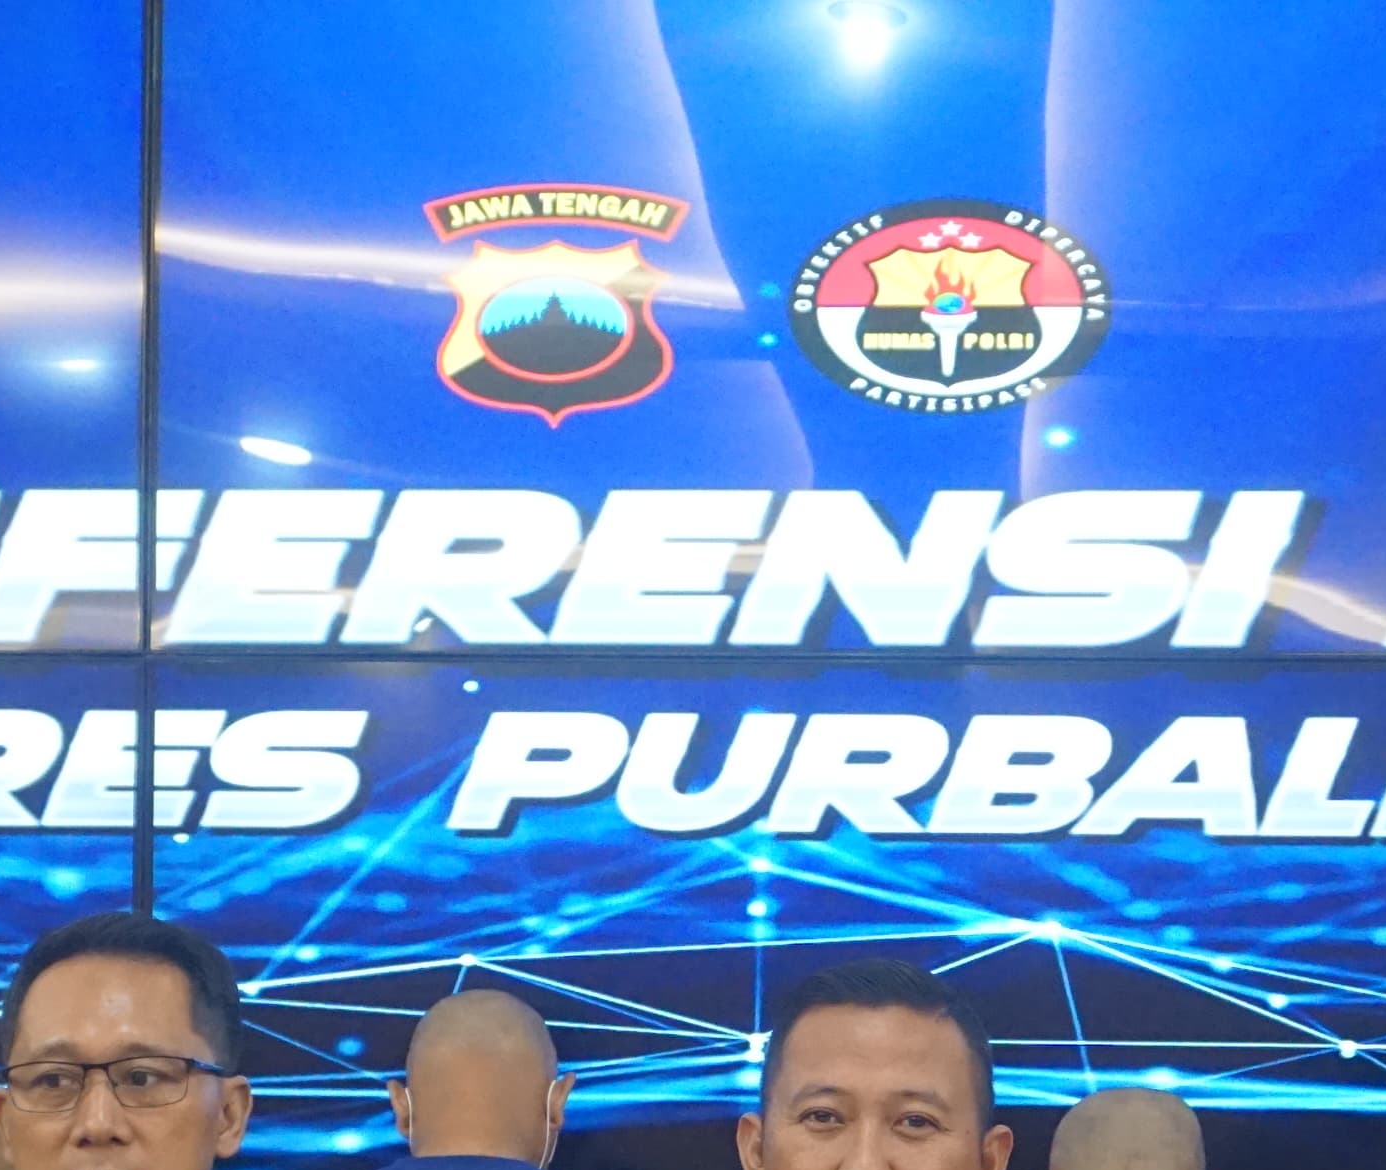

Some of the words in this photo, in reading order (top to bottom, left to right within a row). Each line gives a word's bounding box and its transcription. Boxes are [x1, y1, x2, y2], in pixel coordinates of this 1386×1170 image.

[448, 194, 533, 227] JAWA
[538, 192, 668, 227] TENGAH
[793, 214, 883, 312] OBYEKTIF
[1005, 210, 1106, 320] DIPERCAYA
[863, 332, 936, 350] HUMAS
[963, 332, 1035, 350] POLRI
[849, 377, 1046, 412] PARTISIPASI
